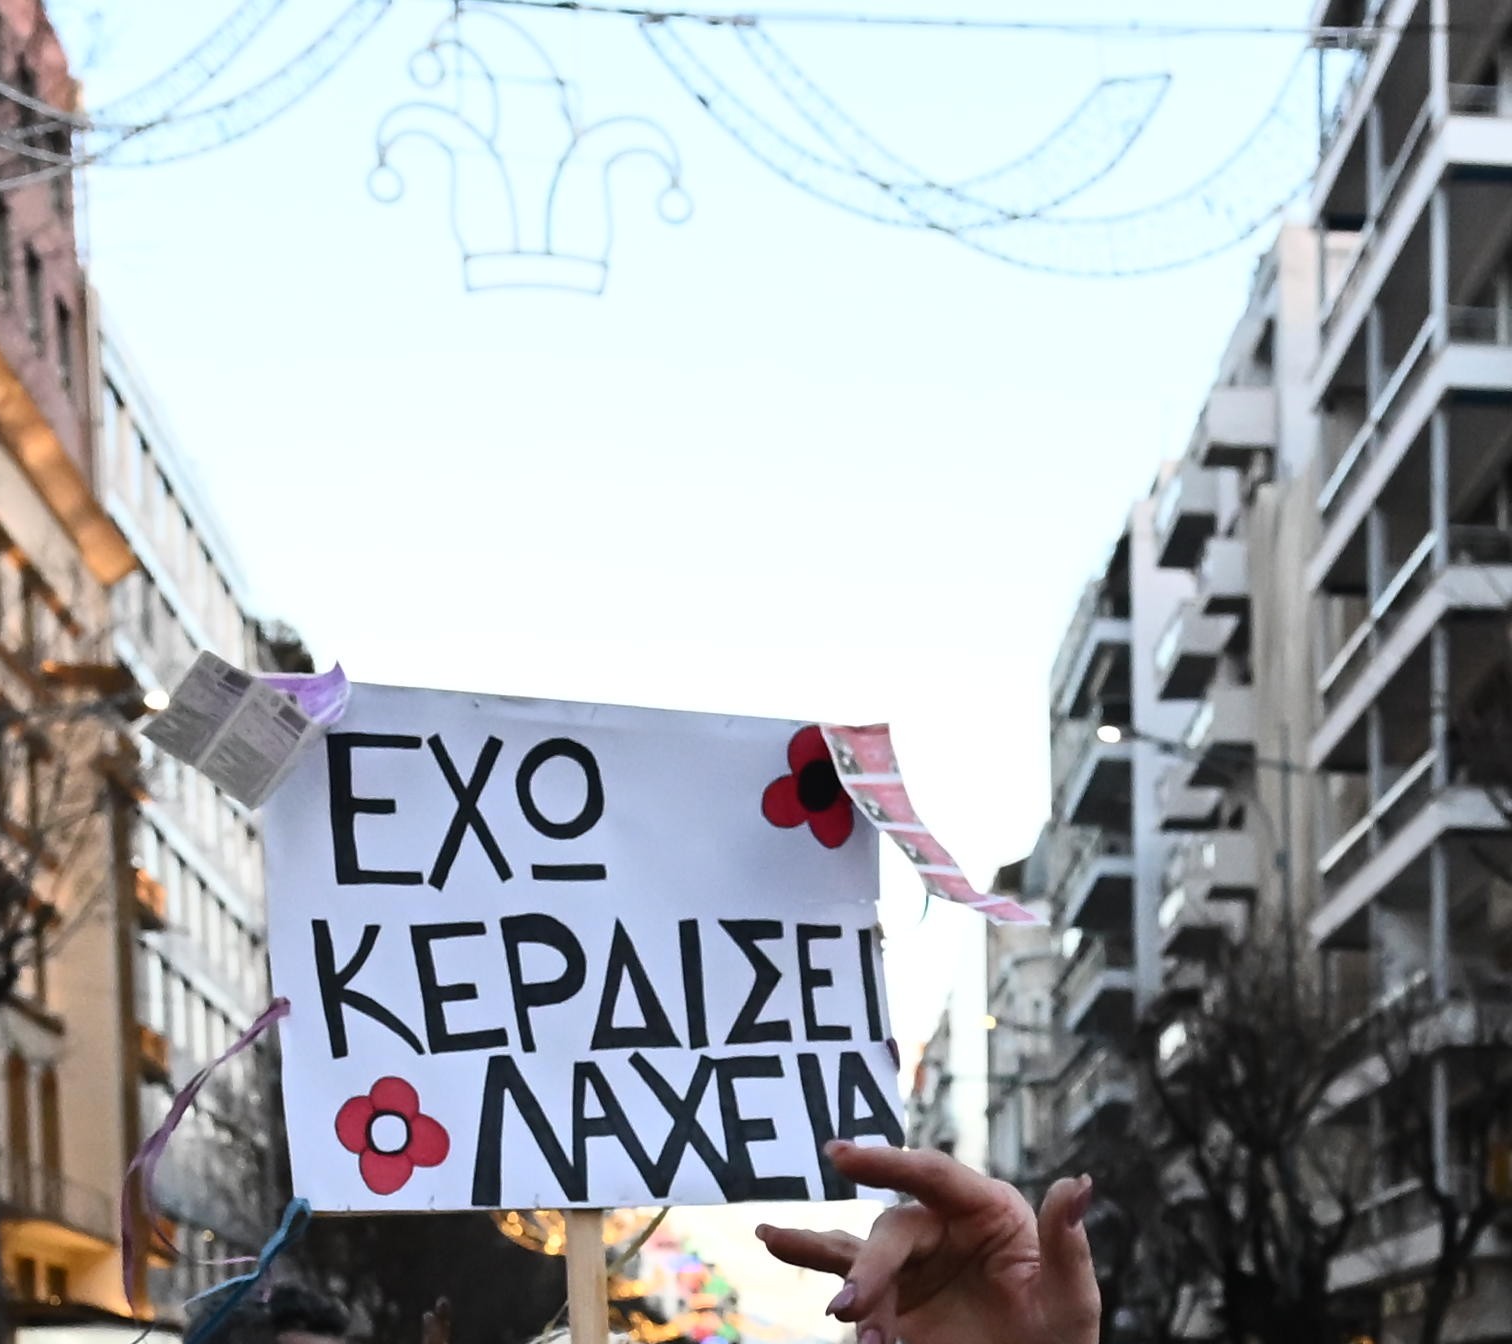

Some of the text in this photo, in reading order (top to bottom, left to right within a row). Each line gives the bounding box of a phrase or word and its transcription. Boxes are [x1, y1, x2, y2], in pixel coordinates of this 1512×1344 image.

[328, 733, 606, 890] ΕΧΩ
[312, 913, 883, 1058] ΚΕΡΔΙΣΕΙ
[471, 1052, 905, 1206] ΛΑΧΕΙΑ
